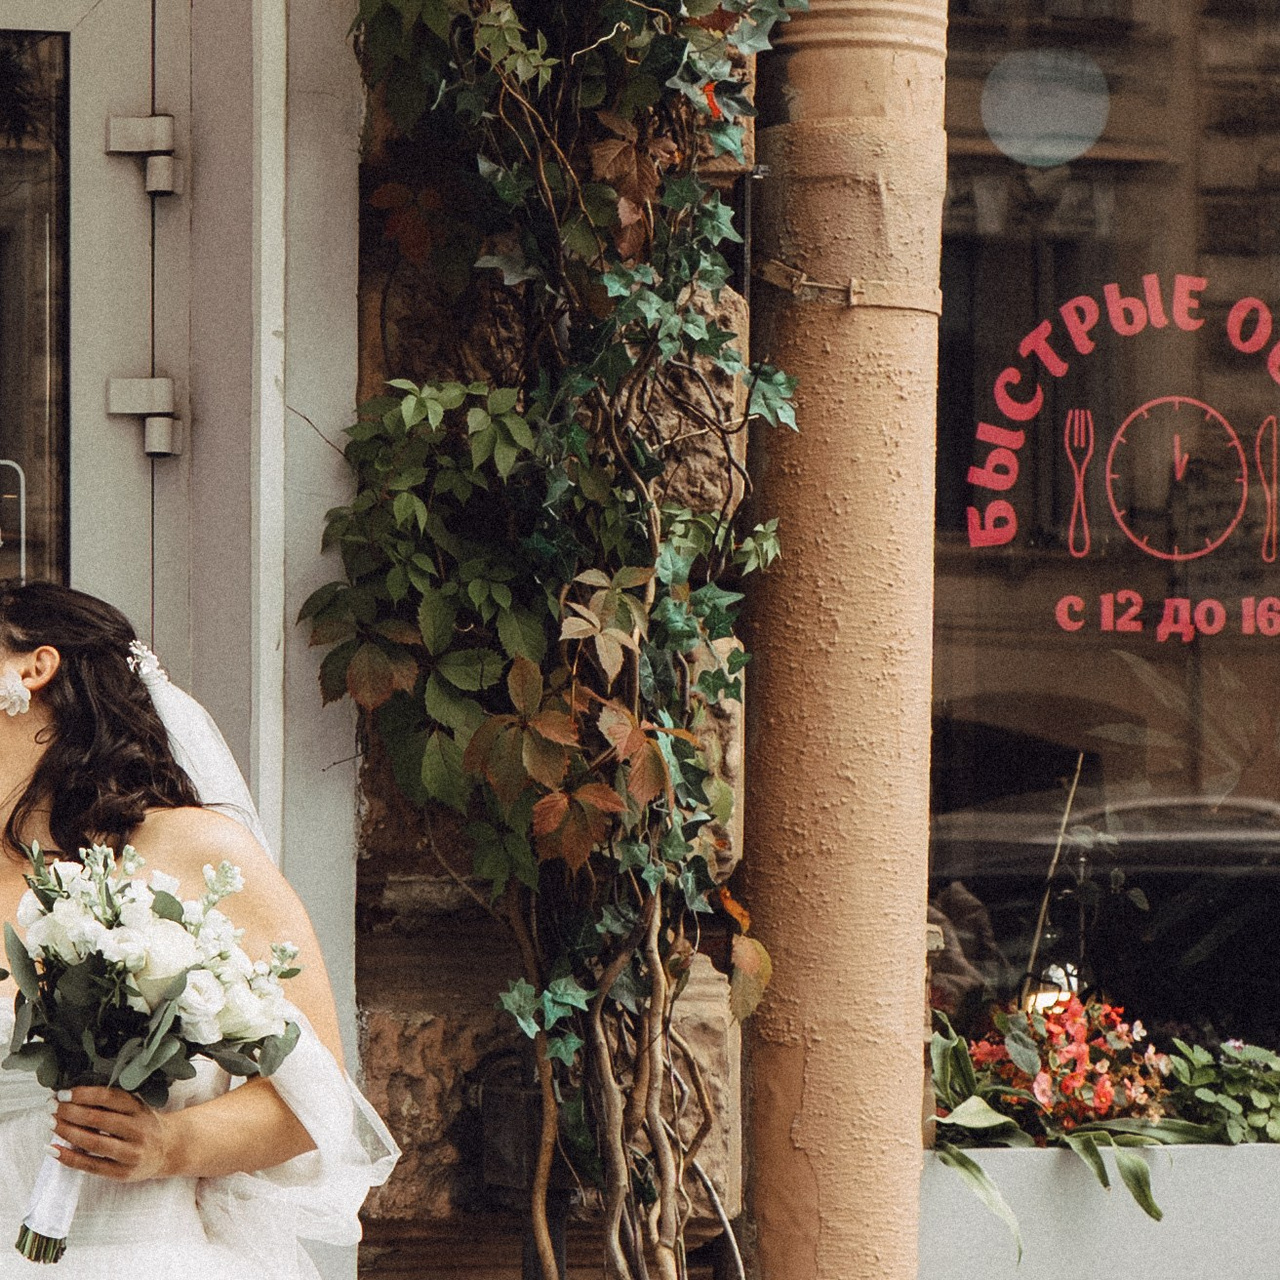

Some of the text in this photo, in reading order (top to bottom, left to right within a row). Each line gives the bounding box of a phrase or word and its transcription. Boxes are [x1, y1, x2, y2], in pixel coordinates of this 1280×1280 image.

[966, 273, 1209, 548] БЫСТРЫЕ
[1099, 589, 1145, 632] 12
[1241, 596, 1280, 637] 16
